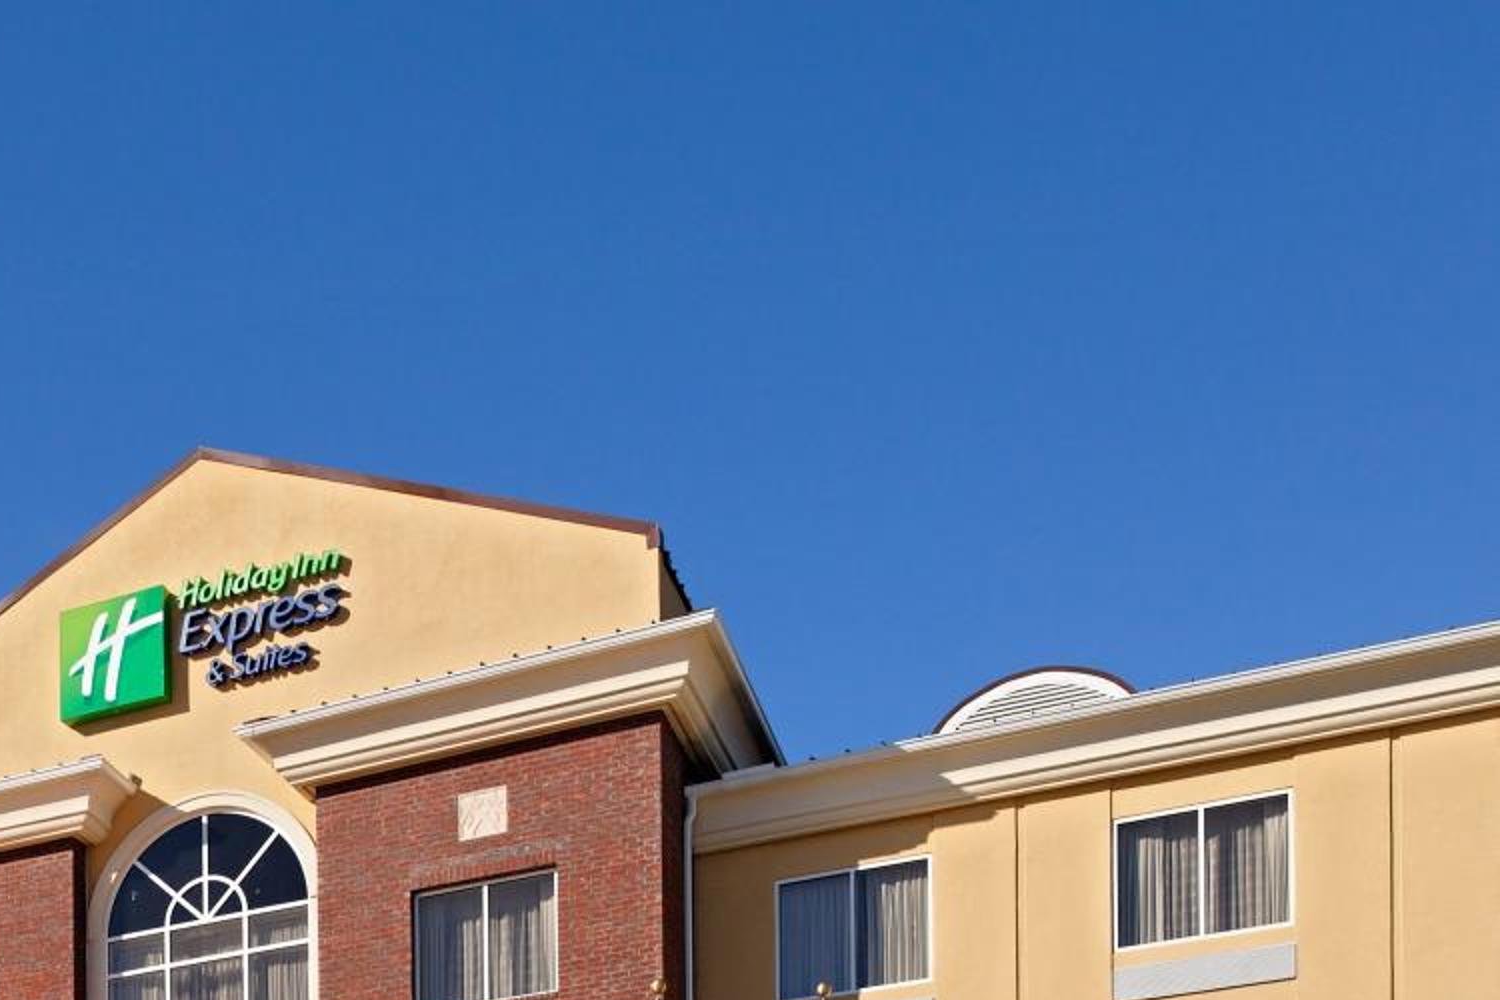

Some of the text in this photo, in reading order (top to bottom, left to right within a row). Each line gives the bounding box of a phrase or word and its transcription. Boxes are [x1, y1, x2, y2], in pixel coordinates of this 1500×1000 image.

[179, 549, 340, 609] Holiday Inn
[179, 582, 341, 656] Express
[206, 641, 309, 687] & Suites
